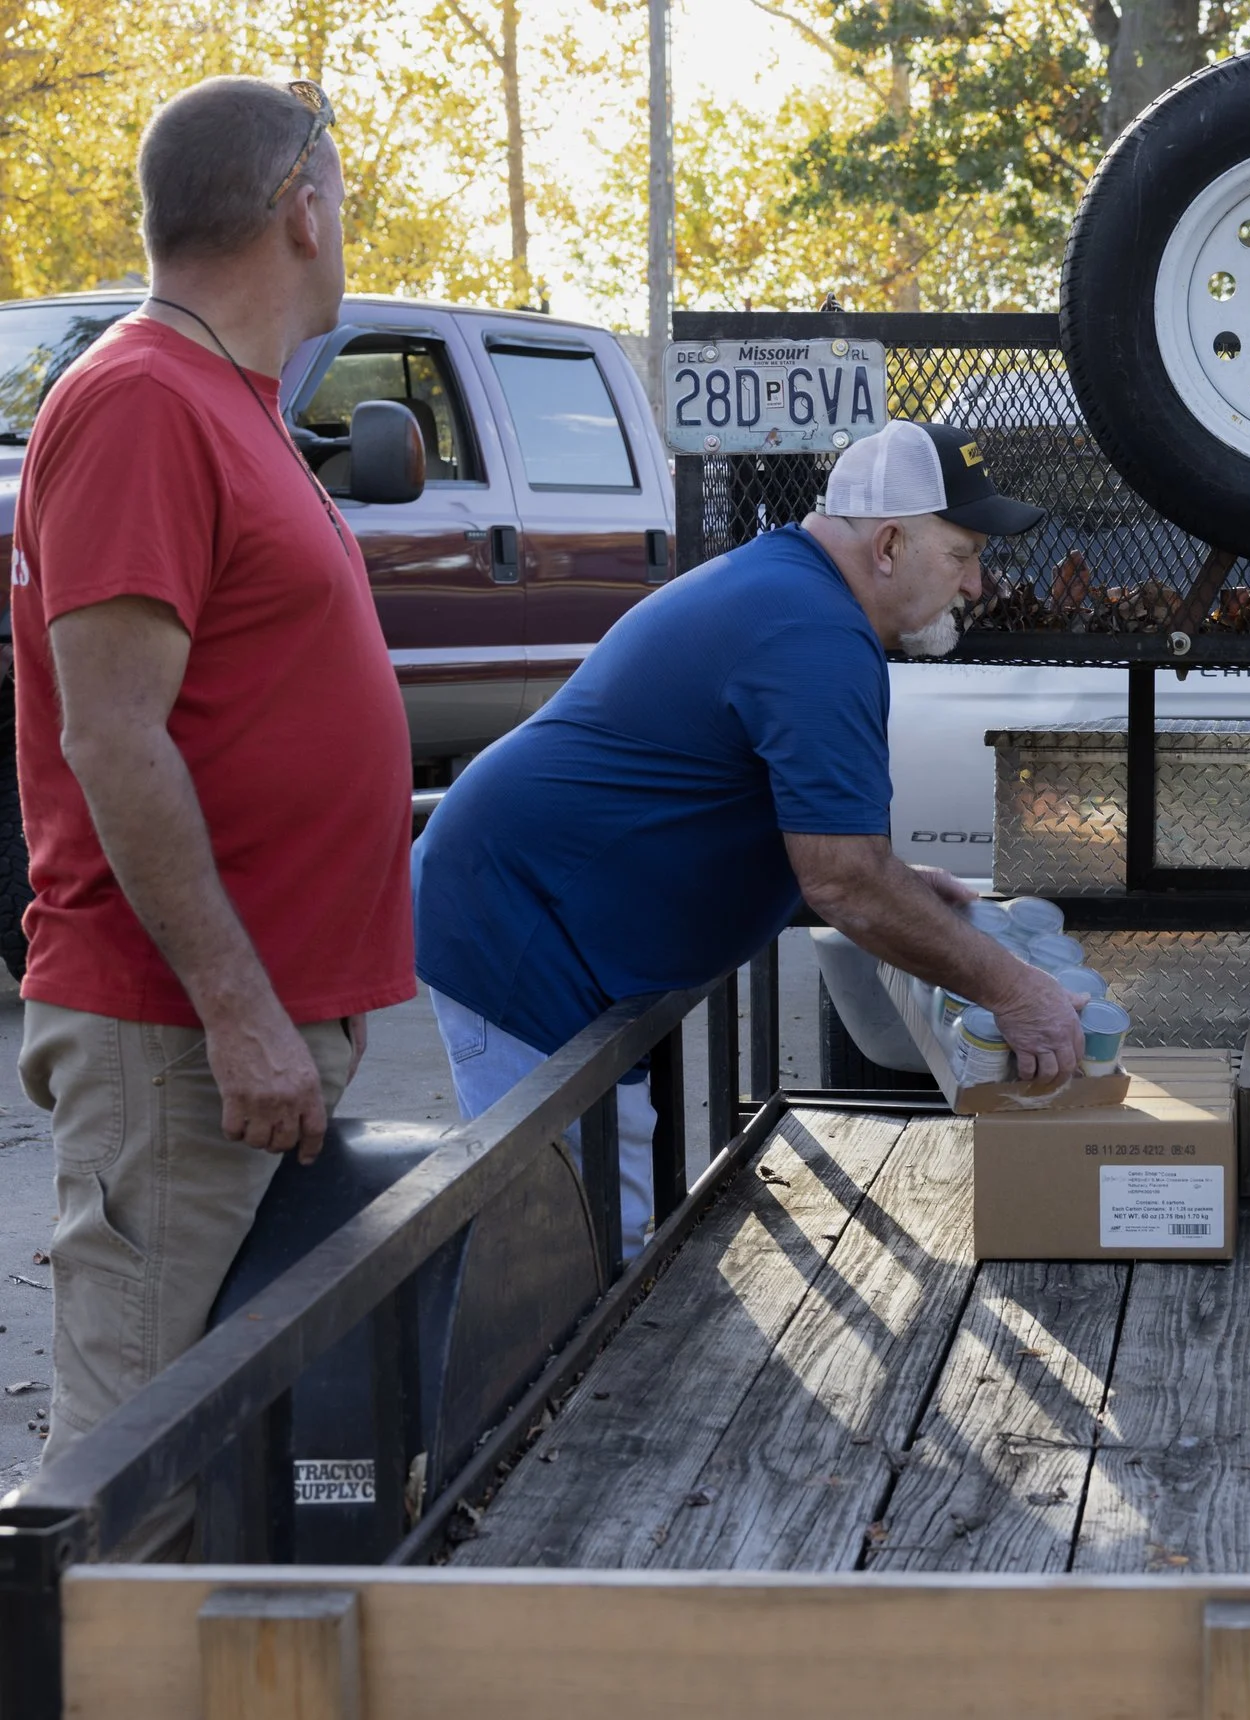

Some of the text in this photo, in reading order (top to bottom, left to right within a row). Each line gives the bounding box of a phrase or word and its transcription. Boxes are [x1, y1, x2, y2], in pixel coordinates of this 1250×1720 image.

[739, 344, 810, 361] Missouri
[675, 367, 760, 427] 28D
[788, 366, 875, 426] 6VA
[1085, 1144, 1098, 1155] BB
[1103, 1145, 1112, 1155] 11
[1116, 1145, 1126, 1155] 20
[1129, 1145, 1140, 1155] 25
